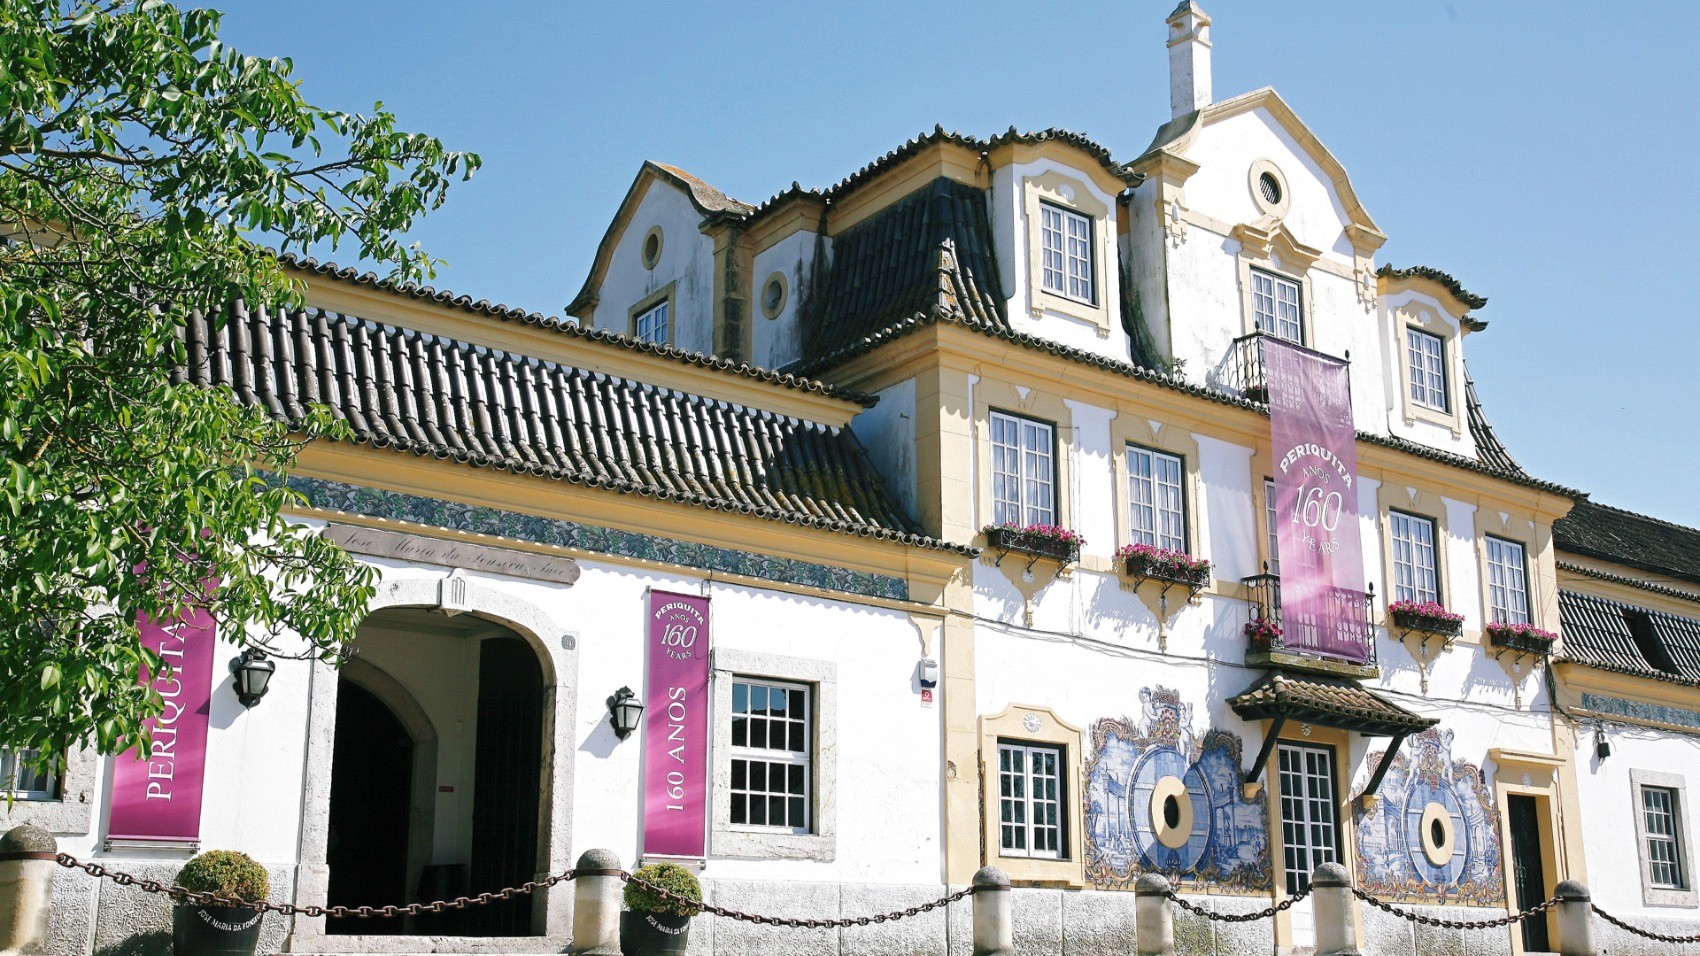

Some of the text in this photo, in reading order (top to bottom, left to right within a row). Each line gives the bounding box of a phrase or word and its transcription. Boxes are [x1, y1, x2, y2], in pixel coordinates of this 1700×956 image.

[1280, 443, 1353, 490] PERIQUITA
[1302, 465, 1330, 484] ANOS
[1291, 483, 1343, 532] 160
[442, 547, 460, 560] da
[1302, 530, 1340, 555] YEARS
[655, 602, 704, 626] PERIQUITA
[669, 612, 690, 623] ANOS
[660, 623, 698, 648] 160
[666, 647, 692, 660] YEARS
[666, 686, 687, 812] 160 ANOS
[211, 918, 232, 931] MARIA
[233, 924, 242, 932] DA
